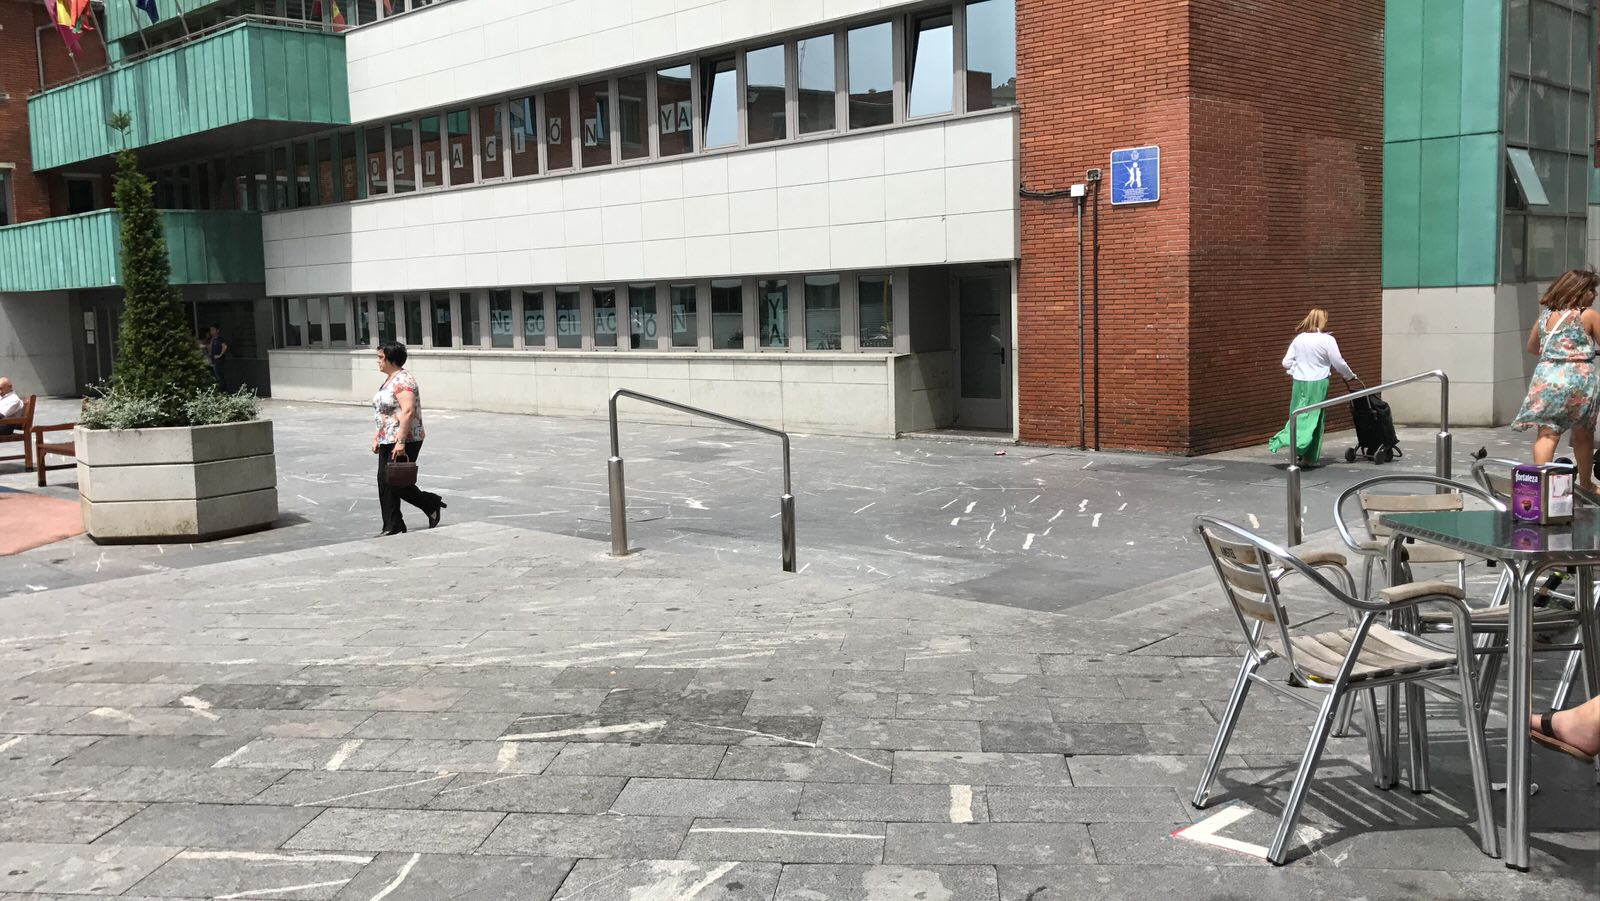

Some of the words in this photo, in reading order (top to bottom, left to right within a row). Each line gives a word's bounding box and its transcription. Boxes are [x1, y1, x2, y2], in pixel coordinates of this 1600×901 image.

[660, 105, 691, 132] YA
[768, 298, 782, 344] YA
[1515, 469, 1538, 483] fortaleza
